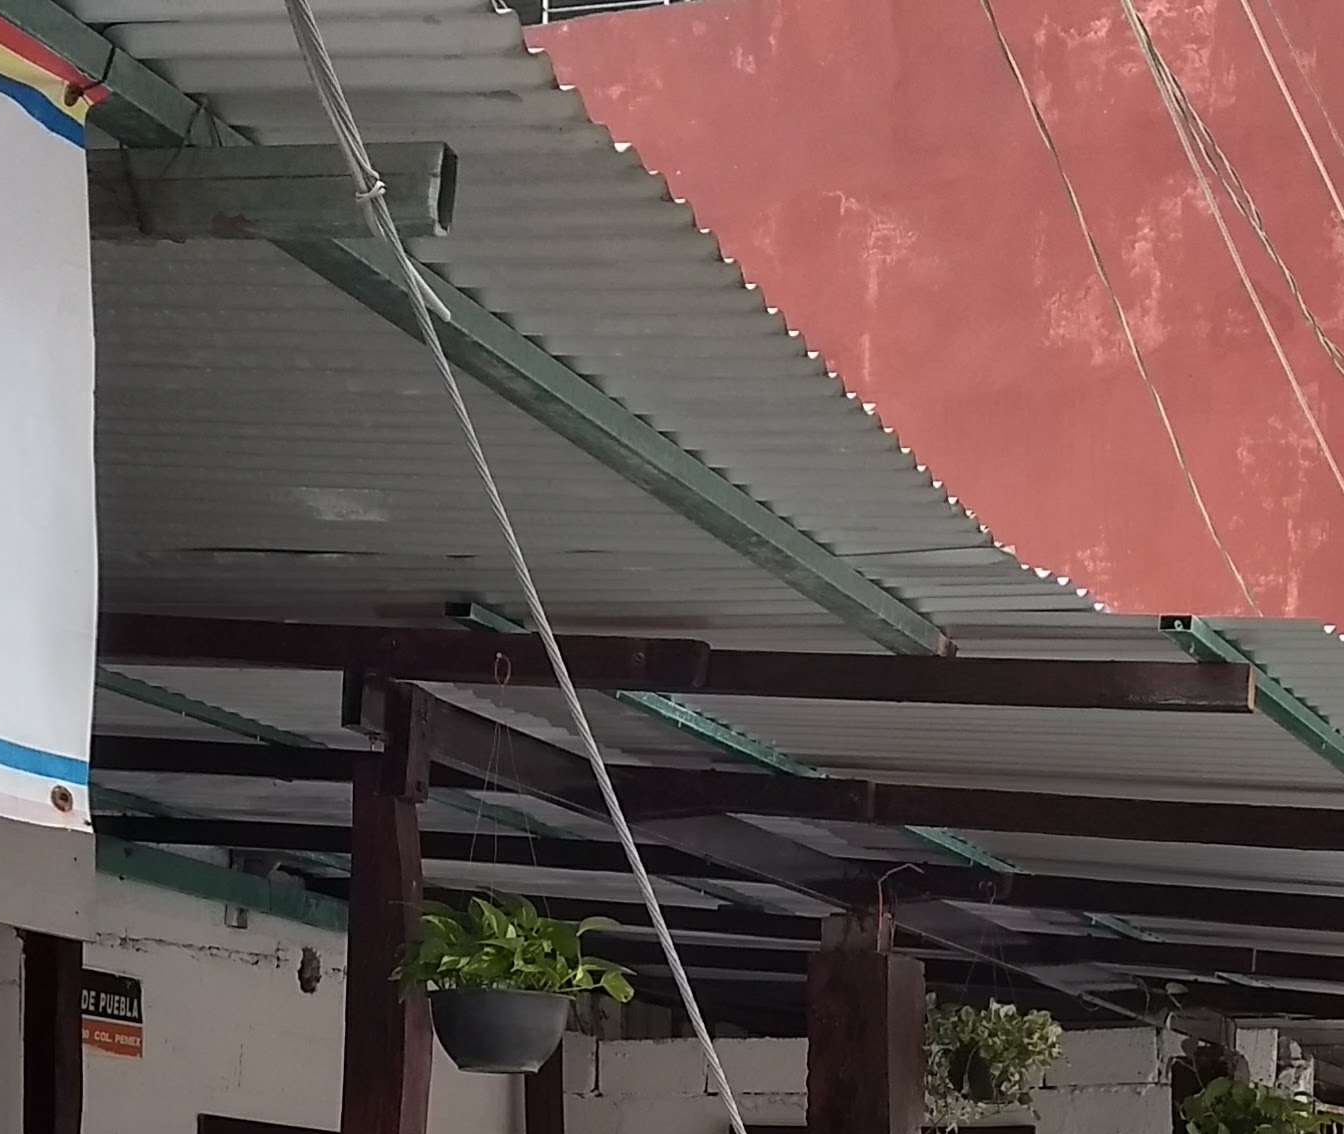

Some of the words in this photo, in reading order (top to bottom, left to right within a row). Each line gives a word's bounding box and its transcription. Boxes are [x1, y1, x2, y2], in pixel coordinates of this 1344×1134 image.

[81, 989, 96, 1012] DE
[98, 992, 139, 1019] PUEBLA
[114, 1033, 141, 1047] PEMEX
